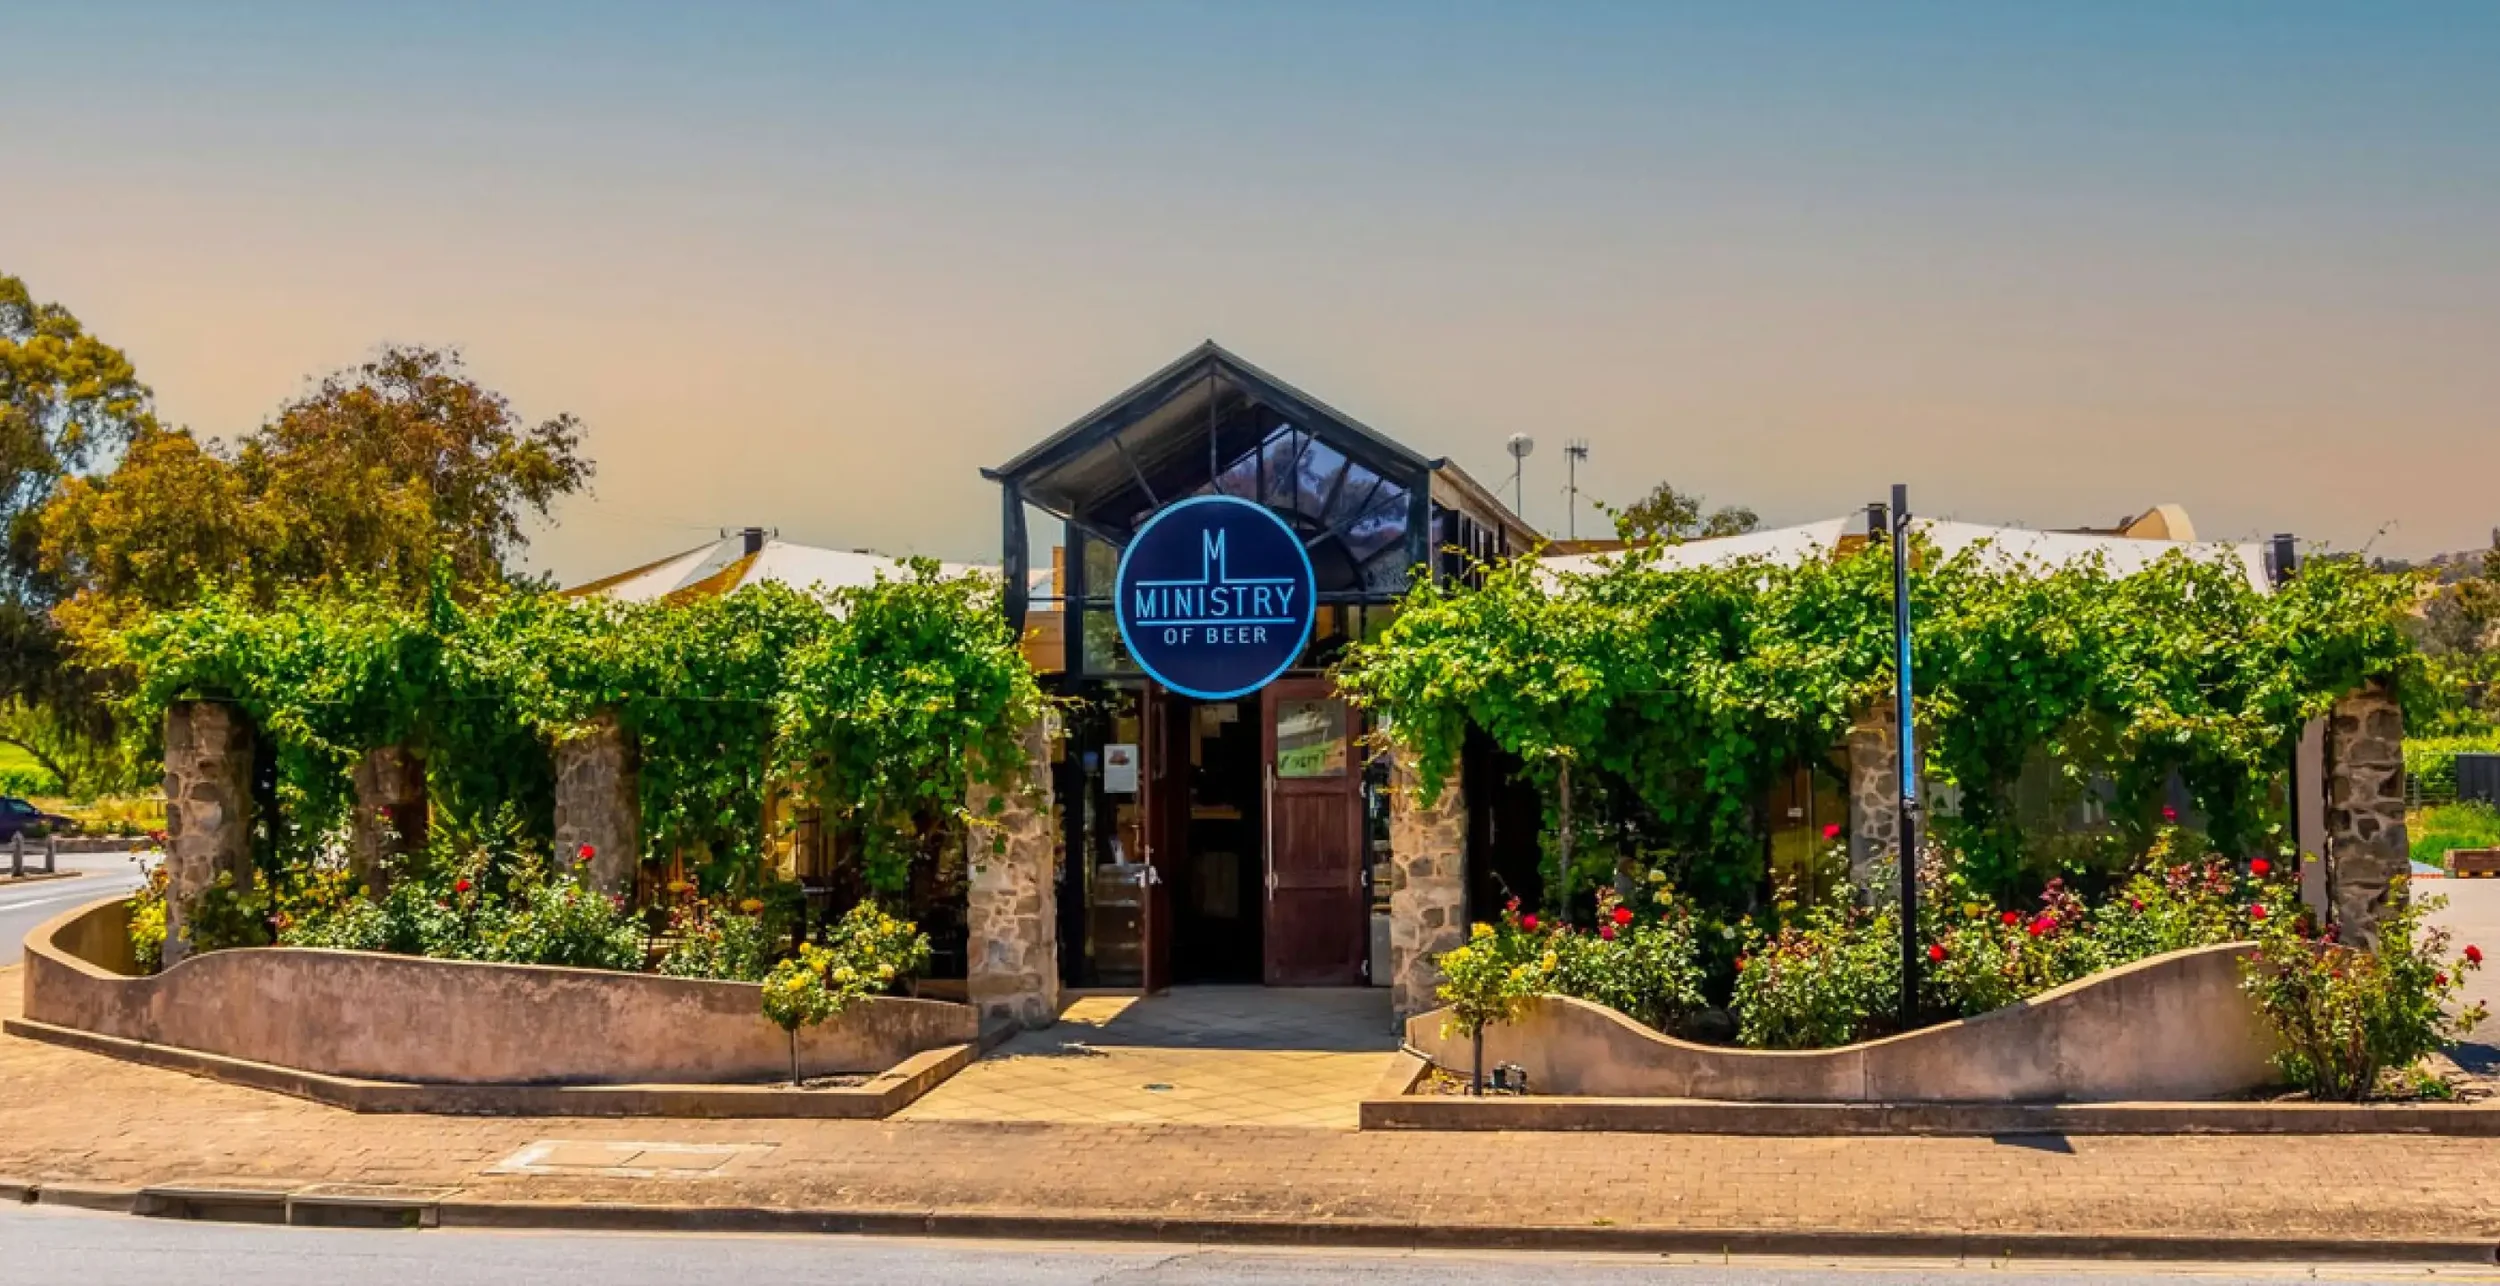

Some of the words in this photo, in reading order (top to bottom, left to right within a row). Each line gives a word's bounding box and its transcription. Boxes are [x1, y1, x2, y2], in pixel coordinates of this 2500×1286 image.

[1203, 527, 1225, 583] M
[1136, 585, 1295, 618] MINISTRY
[1164, 627, 1194, 645] OF
[1206, 626, 1268, 644] BEER
